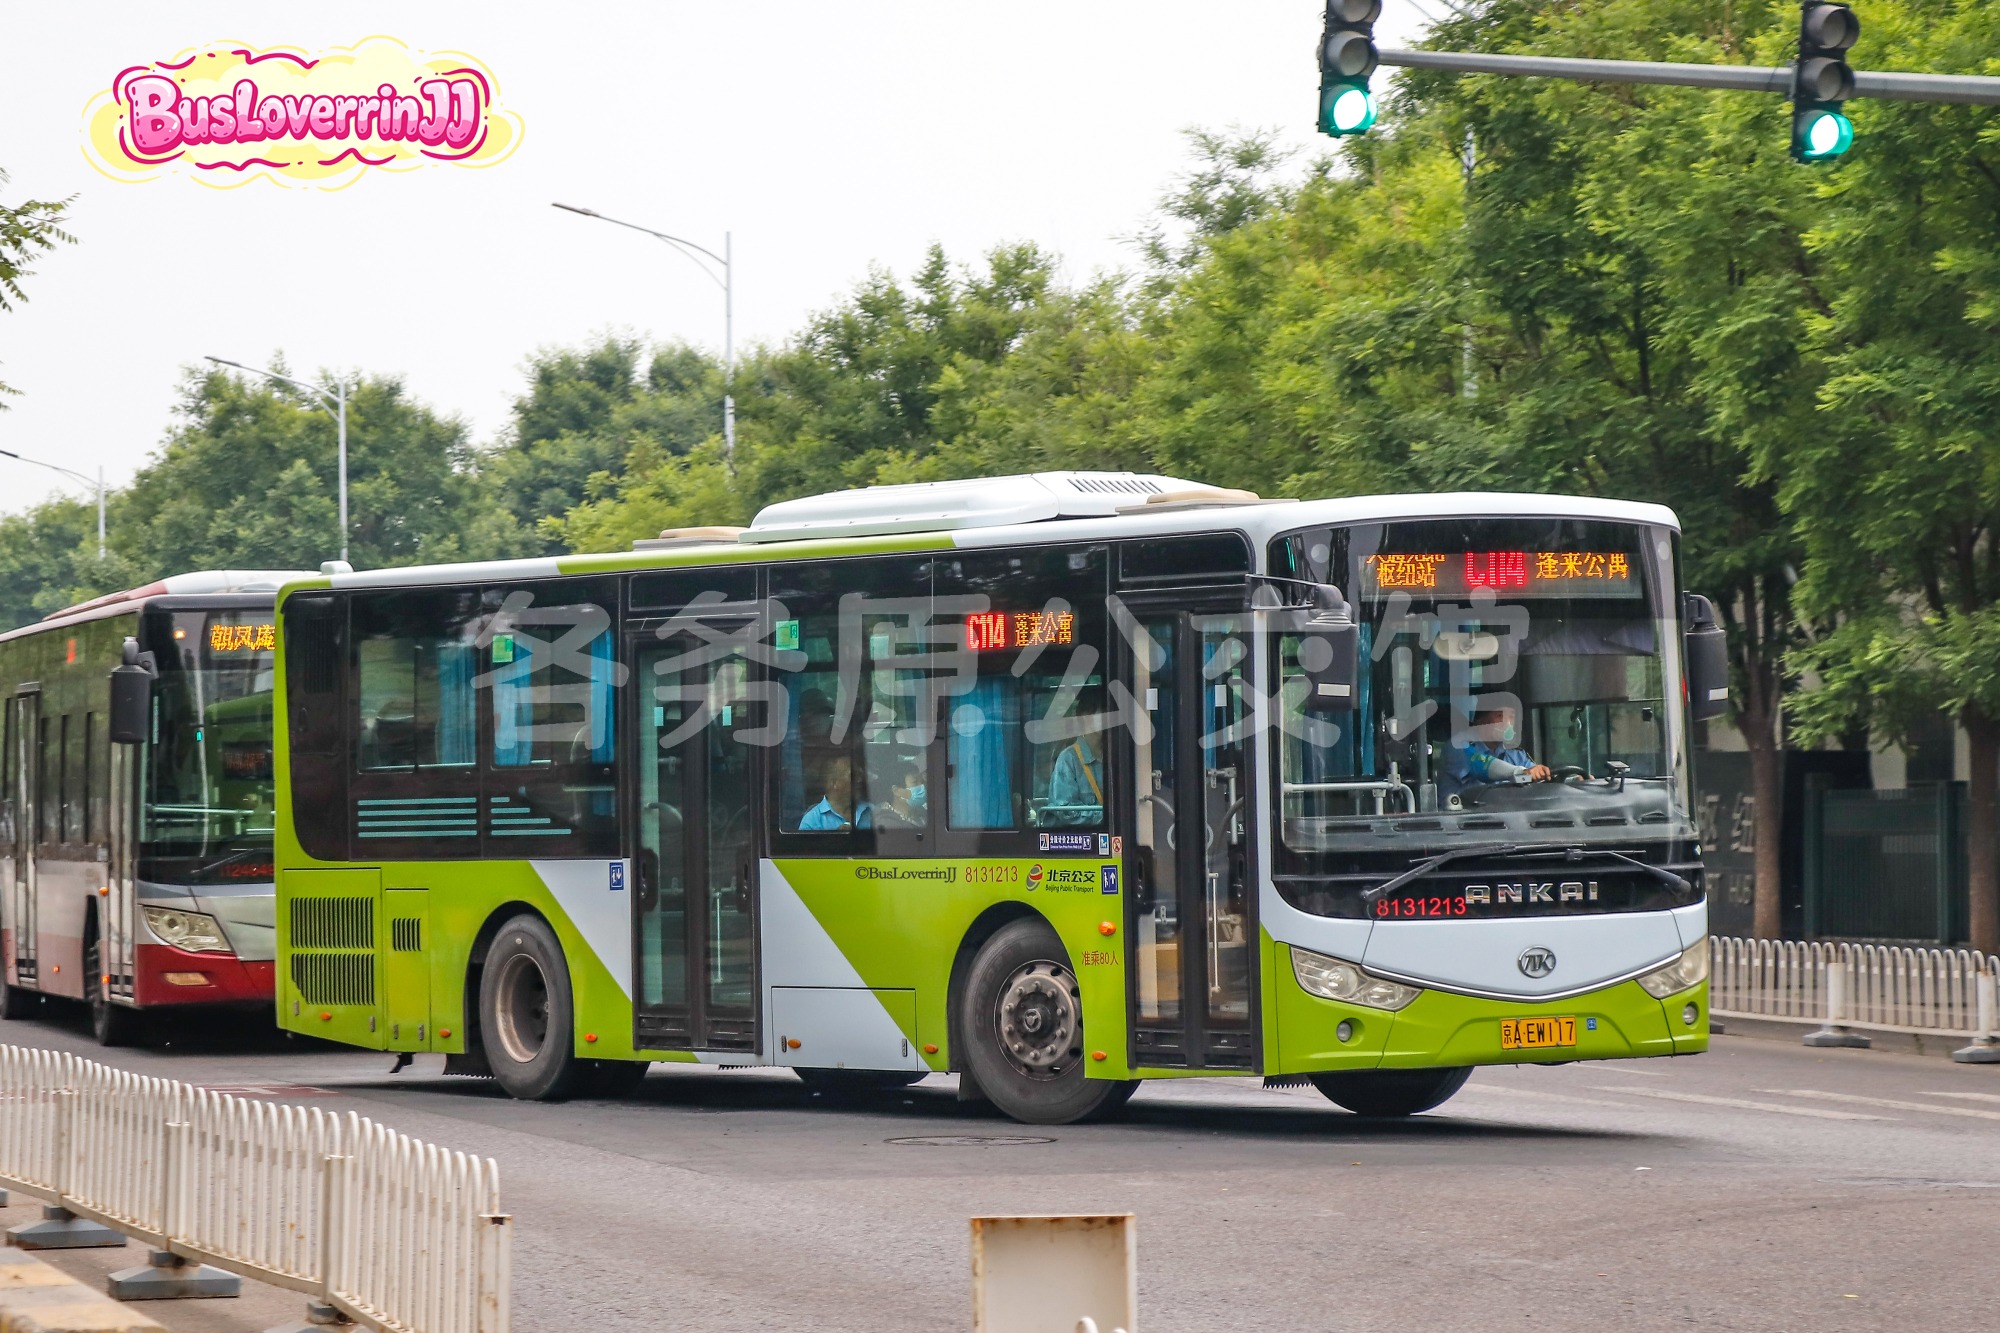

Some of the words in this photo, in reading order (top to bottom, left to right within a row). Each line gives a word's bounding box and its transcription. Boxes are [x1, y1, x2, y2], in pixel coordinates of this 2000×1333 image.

[969, 614, 1006, 649] C114
[1014, 610, 1074, 647] 蓬莱公寓
[965, 866, 1018, 883] 8131213
[1046, 869, 1096, 883] 北京公交
[1045, 884, 1060, 893] Beijing
[1060, 885, 1073, 893] Public
[1073, 885, 1094, 893] Transport
[1465, 881, 1598, 904] ANKAI
[1376, 897, 1466, 916] 8131213
[1081, 950, 1119, 966] 准乘80人
